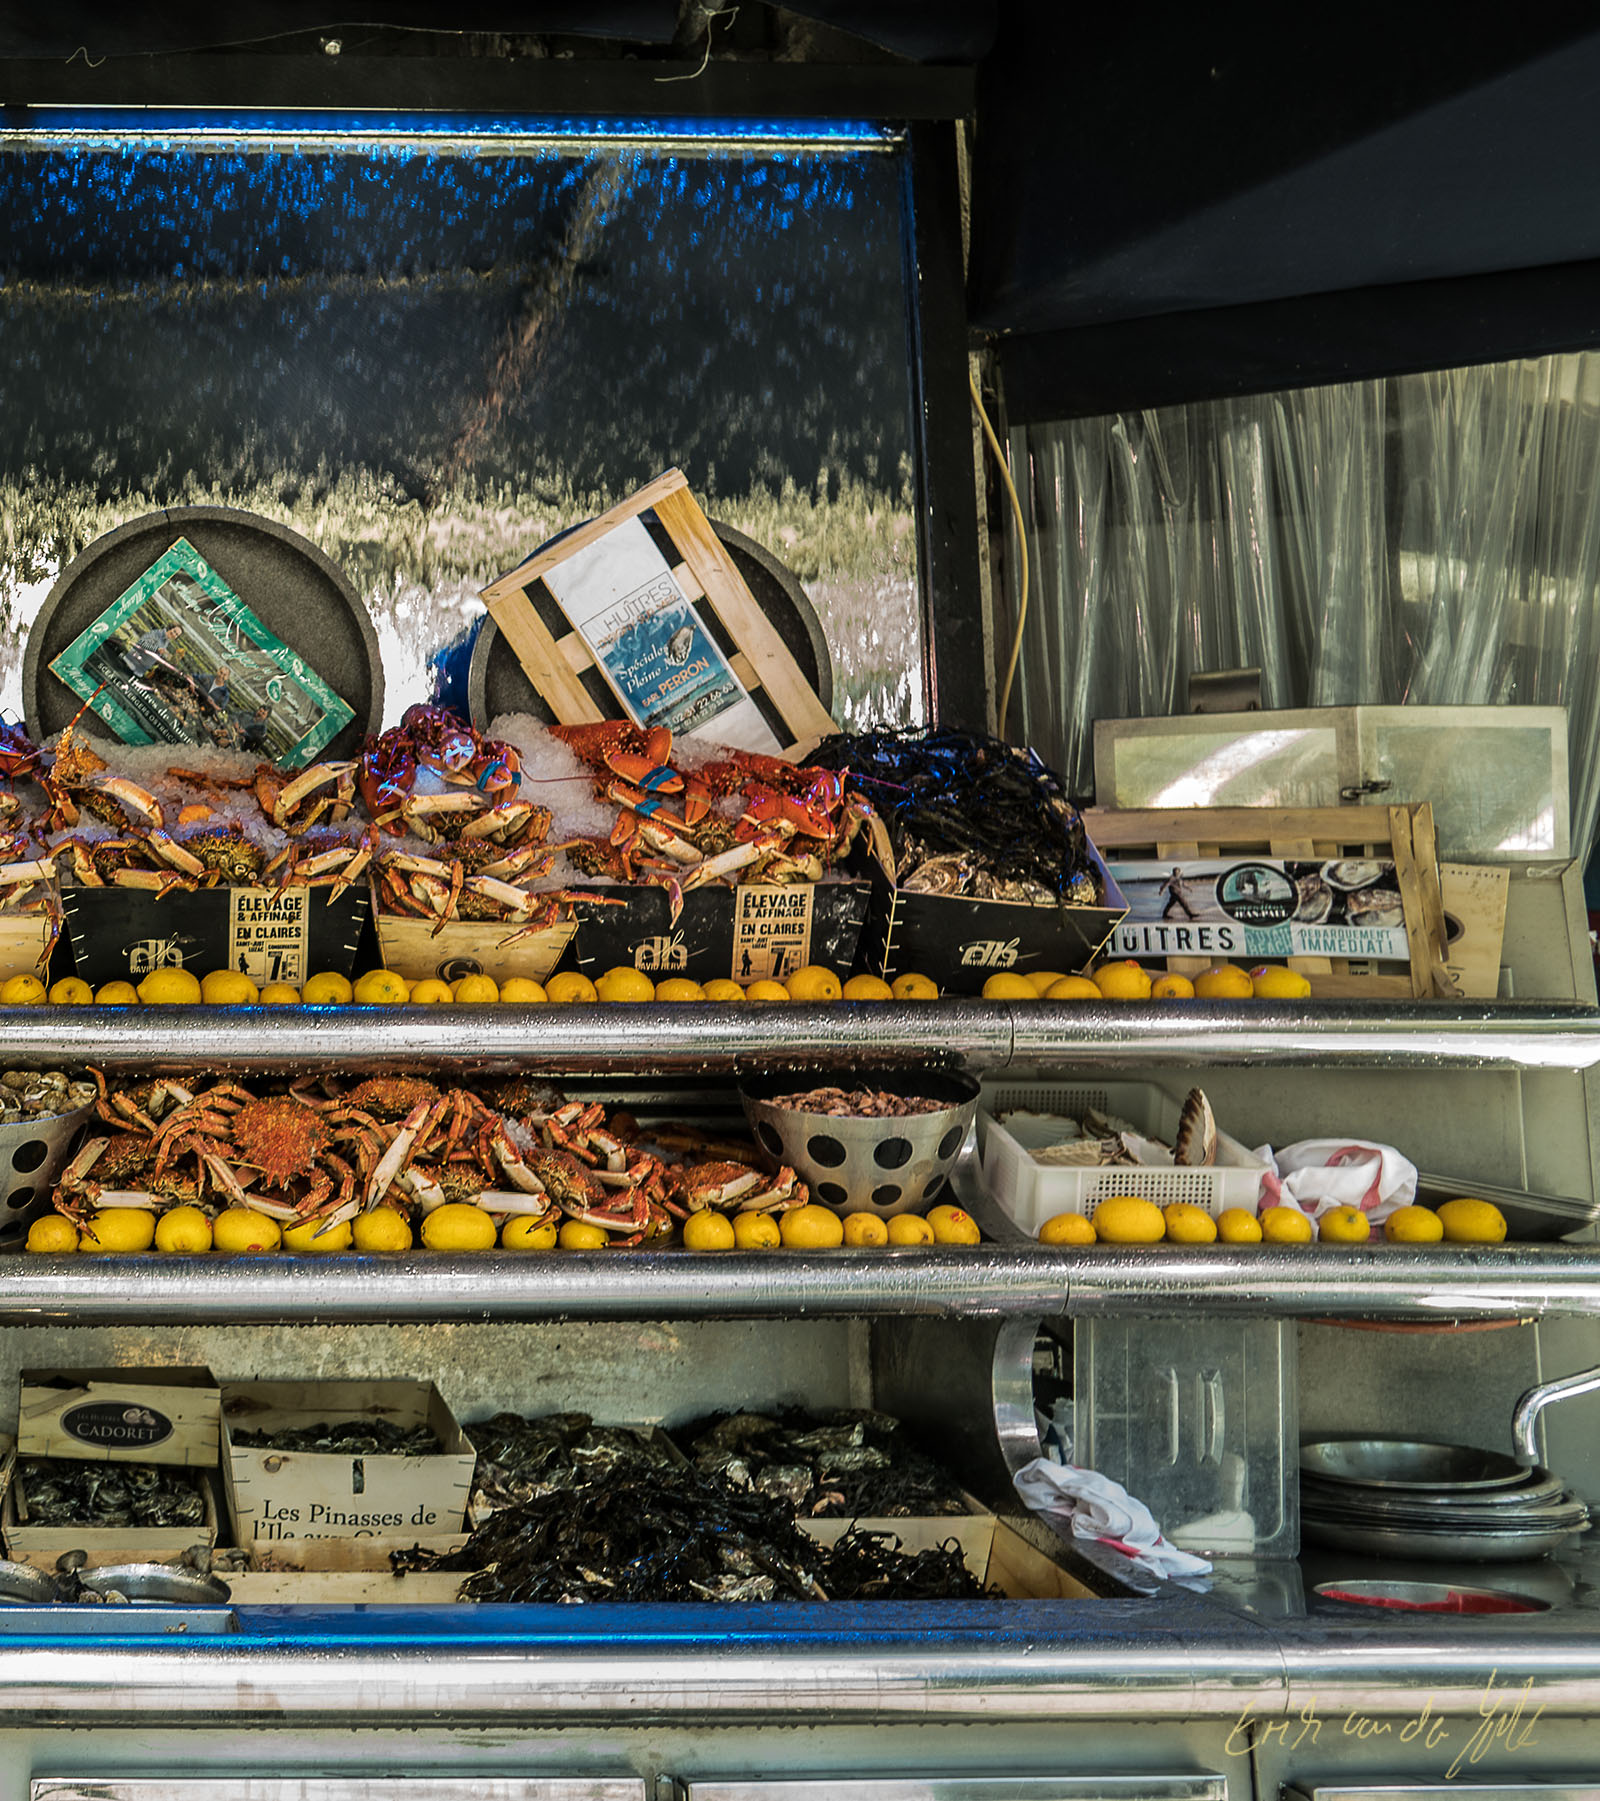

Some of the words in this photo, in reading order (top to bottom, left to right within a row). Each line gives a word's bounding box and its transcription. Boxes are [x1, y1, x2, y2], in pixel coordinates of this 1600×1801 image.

[626, 668, 662, 694] Pleine
[658, 656, 710, 696] PERRON
[237, 895, 303, 912] ÉLEVAGE
[743, 892, 807, 908] ÉLEVAGE
[237, 912, 246, 922] &
[250, 911, 302, 922] AFFINAGE
[743, 909, 751, 918] &
[755, 908, 806, 919] AFFINAGE
[236, 927, 251, 939] EN
[256, 927, 302, 939] CLAIRES
[741, 923, 756, 935] EN
[760, 923, 805, 935] CLAIRES
[267, 951, 283, 980] 7
[771, 947, 786, 977] 7
[76, 1422, 159, 1441] CADORET
[263, 1499, 300, 1522] Les
[309, 1503, 403, 1526] Pinasses
[410, 1504, 437, 1526] de
